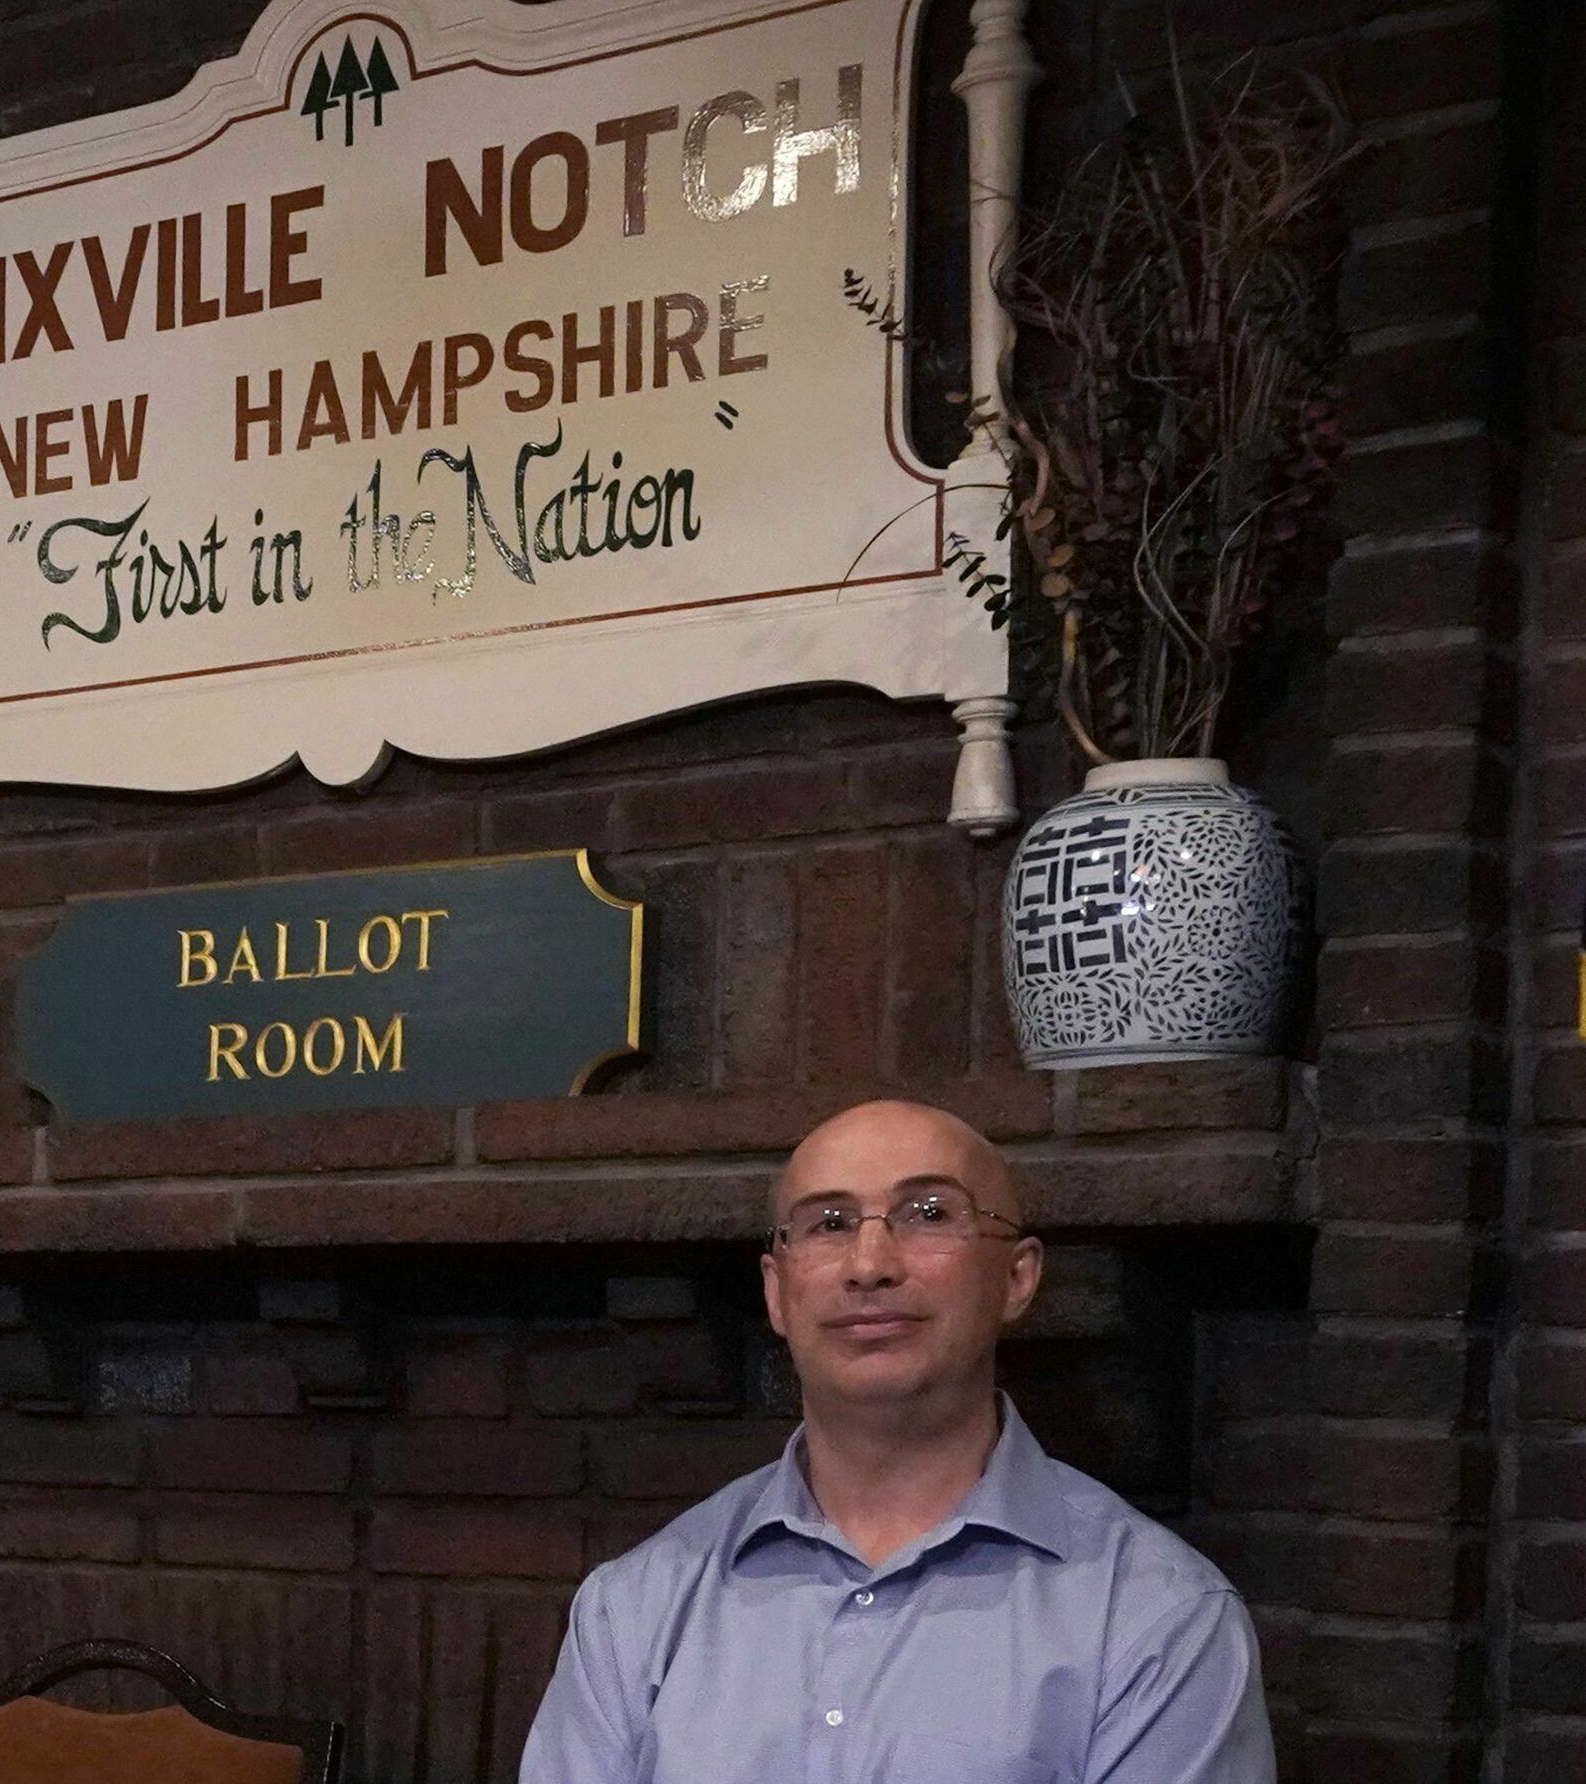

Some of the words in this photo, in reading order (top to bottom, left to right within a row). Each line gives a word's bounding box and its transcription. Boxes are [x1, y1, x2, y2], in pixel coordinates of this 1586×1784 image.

[425, 63, 863, 277] NOTCH
[234, 274, 769, 462] HAMPSHIRE
[7, 497, 227, 650] "First
[250, 508, 314, 605] in
[340, 458, 437, 594] the
[176, 910, 449, 987] BALLOT
[206, 1012, 406, 1082] ROOM
